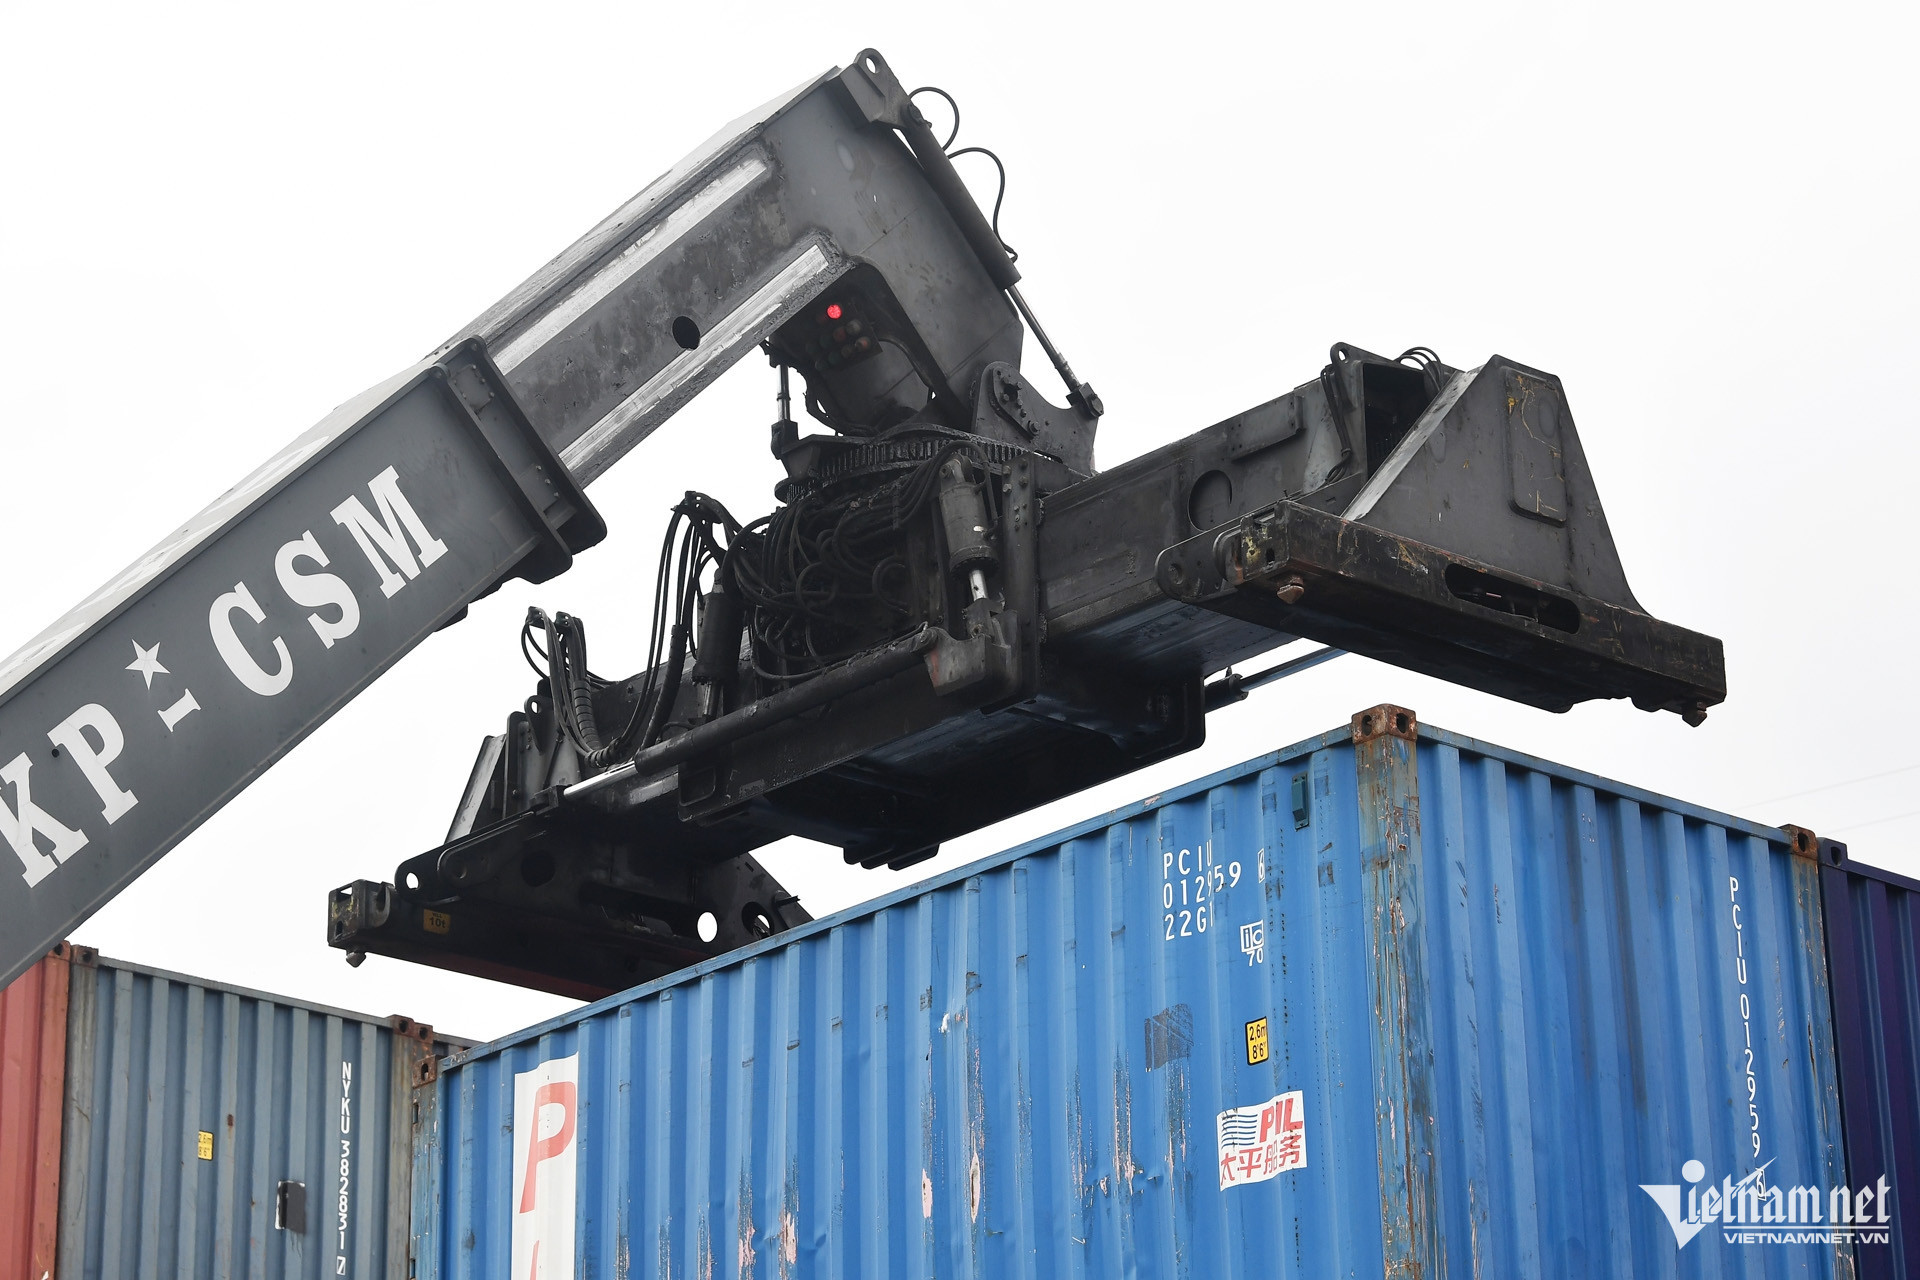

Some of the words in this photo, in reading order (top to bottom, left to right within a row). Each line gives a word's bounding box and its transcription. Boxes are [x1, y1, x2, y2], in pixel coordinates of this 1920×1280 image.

[1163, 839, 1212, 879] PCIU
[1164, 900, 1213, 941] 22G1
[1729, 876, 1747, 985] PCIU
[1247, 947, 1264, 967] 70
[341, 1061, 352, 1134] NYKU
[1259, 1098, 1303, 1143] PIL
[338, 1139, 350, 1250] 382831
